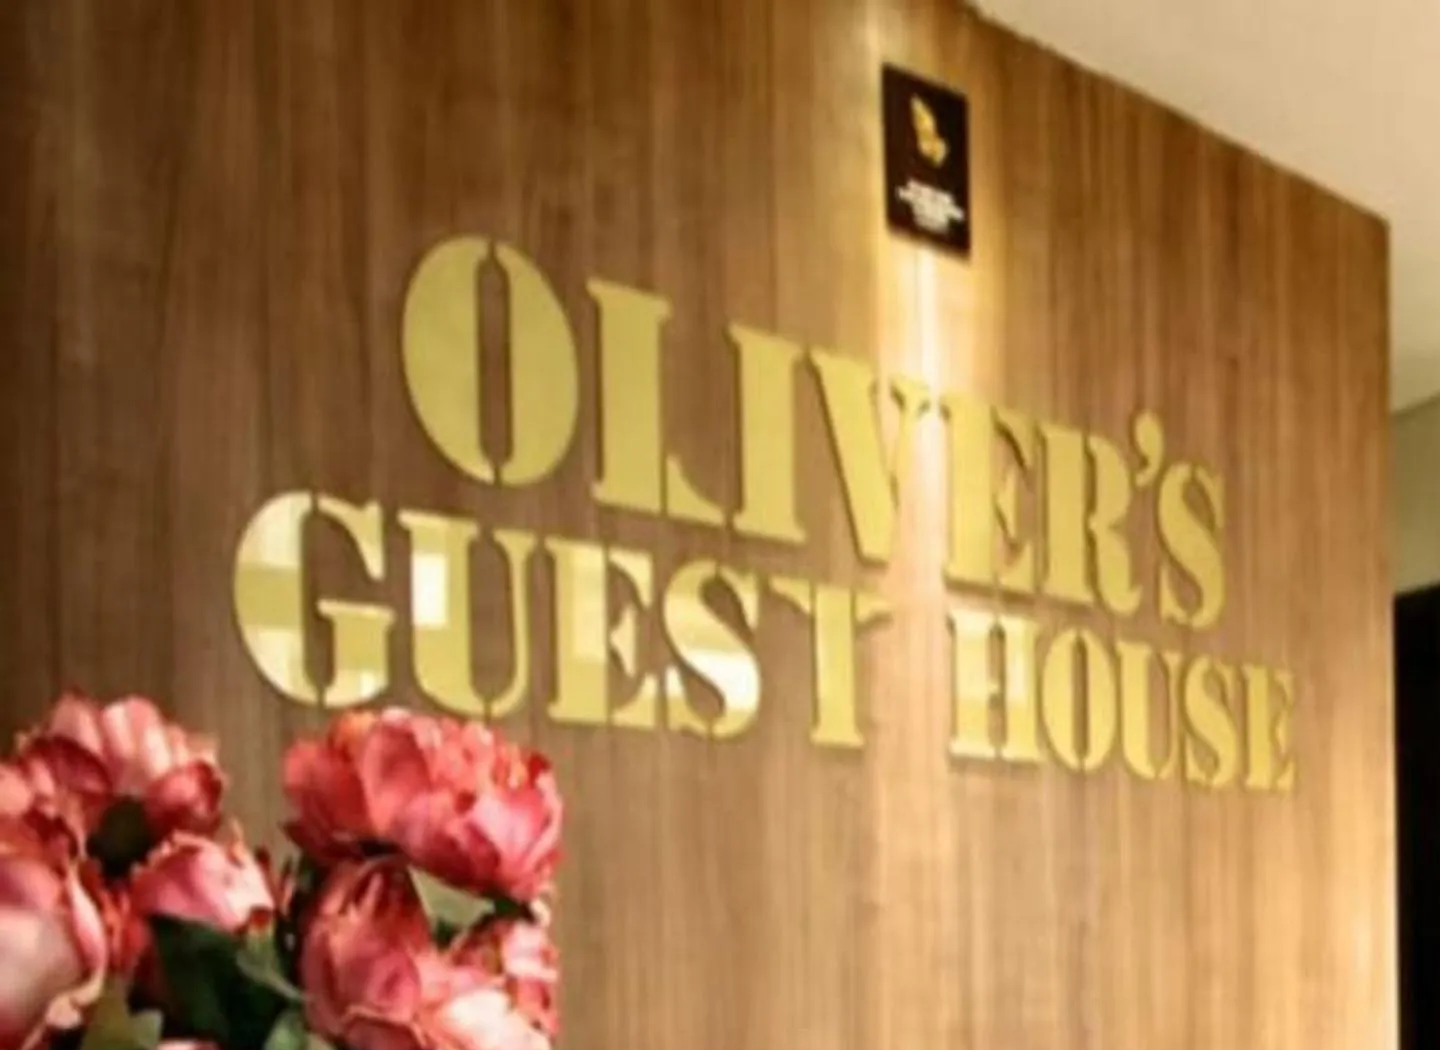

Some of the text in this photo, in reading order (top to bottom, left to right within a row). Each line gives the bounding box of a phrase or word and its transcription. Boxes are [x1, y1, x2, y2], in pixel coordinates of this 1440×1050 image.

[401, 236, 1226, 628] OLIVER'S
[234, 490, 1296, 790] GUEST HOUSE
